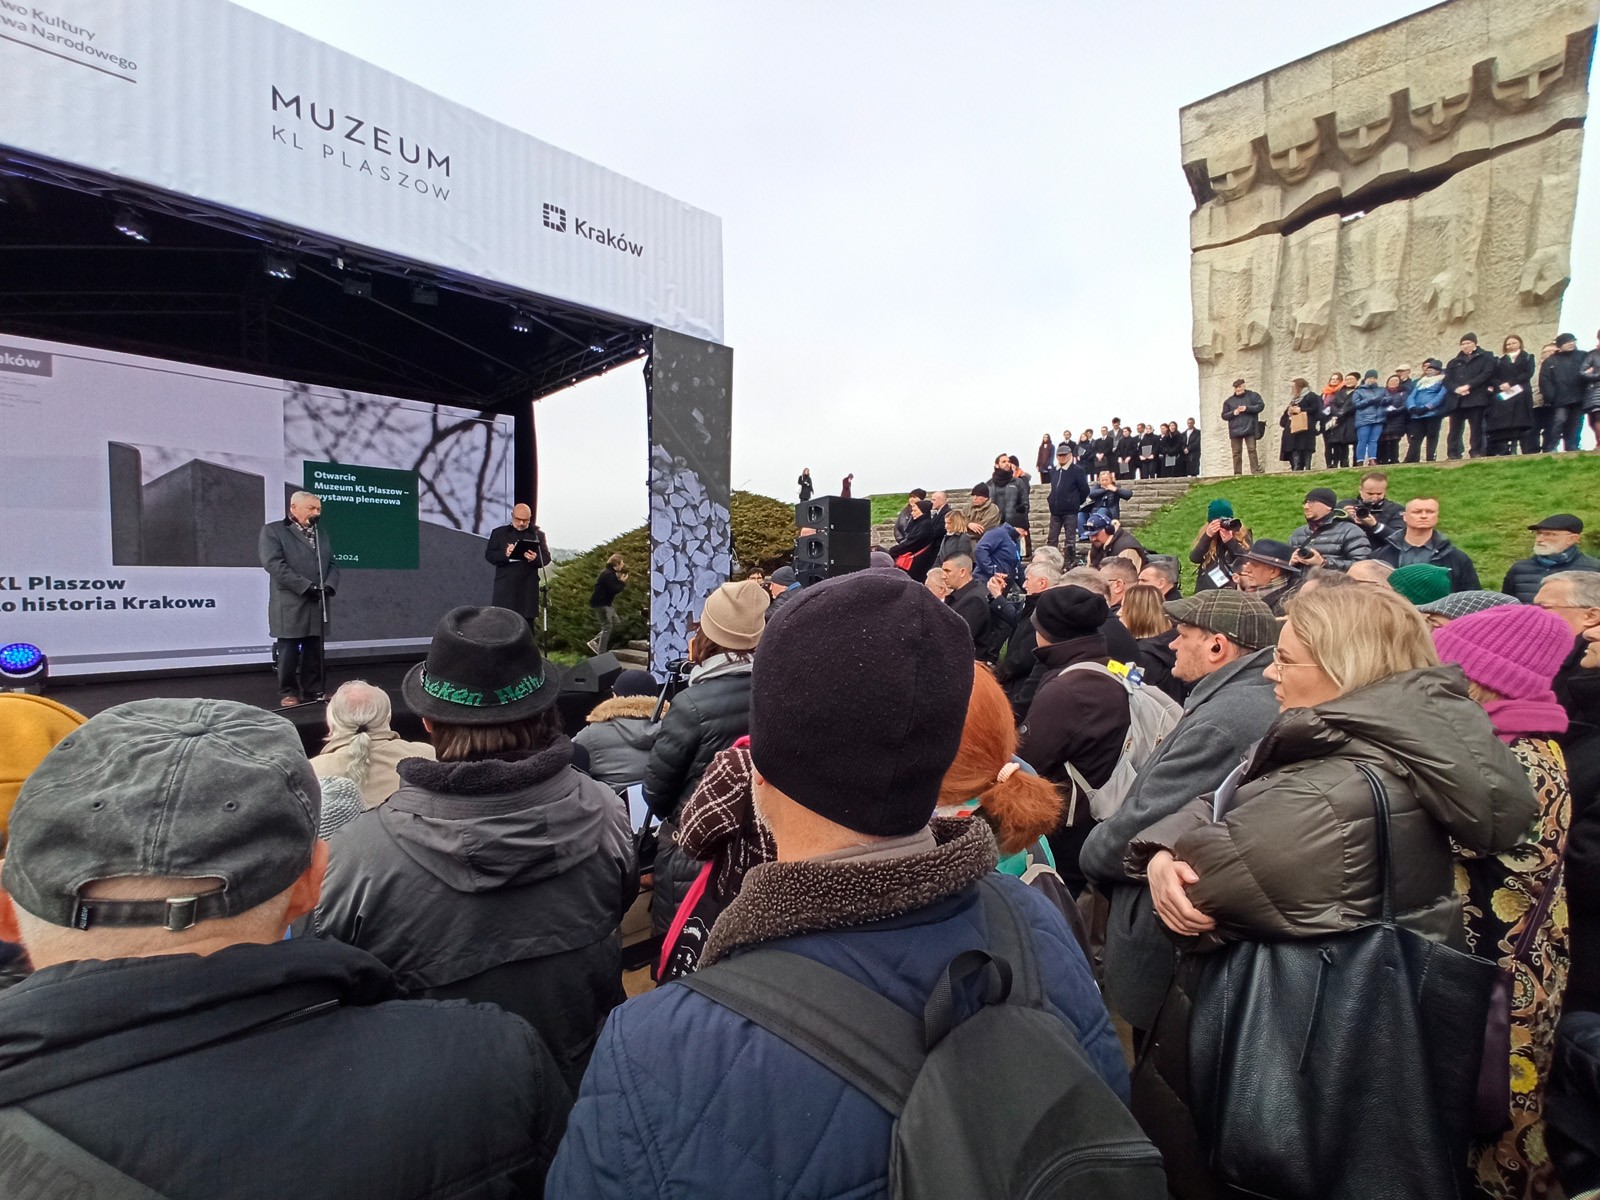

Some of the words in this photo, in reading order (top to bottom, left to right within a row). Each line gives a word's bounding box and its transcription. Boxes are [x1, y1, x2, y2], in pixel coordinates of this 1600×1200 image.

[0, 0, 28, 16] wo
[32, 8, 96, 41] Kultury
[0, 15, 28, 32] wa
[32, 23, 138, 70] Narodowego
[271, 84, 451, 178] MUZEUM
[272, 124, 304, 151] KL
[322, 143, 450, 202] PLASZOW
[575, 217, 644, 258] Kraków
[314, 471, 357, 482] Otwarcie
[314, 482, 354, 492] Muzeum
[355, 485, 367, 493] KL
[368, 486, 403, 496] Plaszow
[0, 601, 17, 612] o
[22, 596, 116, 612] historia
[122, 595, 216, 610] Krakowa
[29, 576, 126, 590] Plaszow
